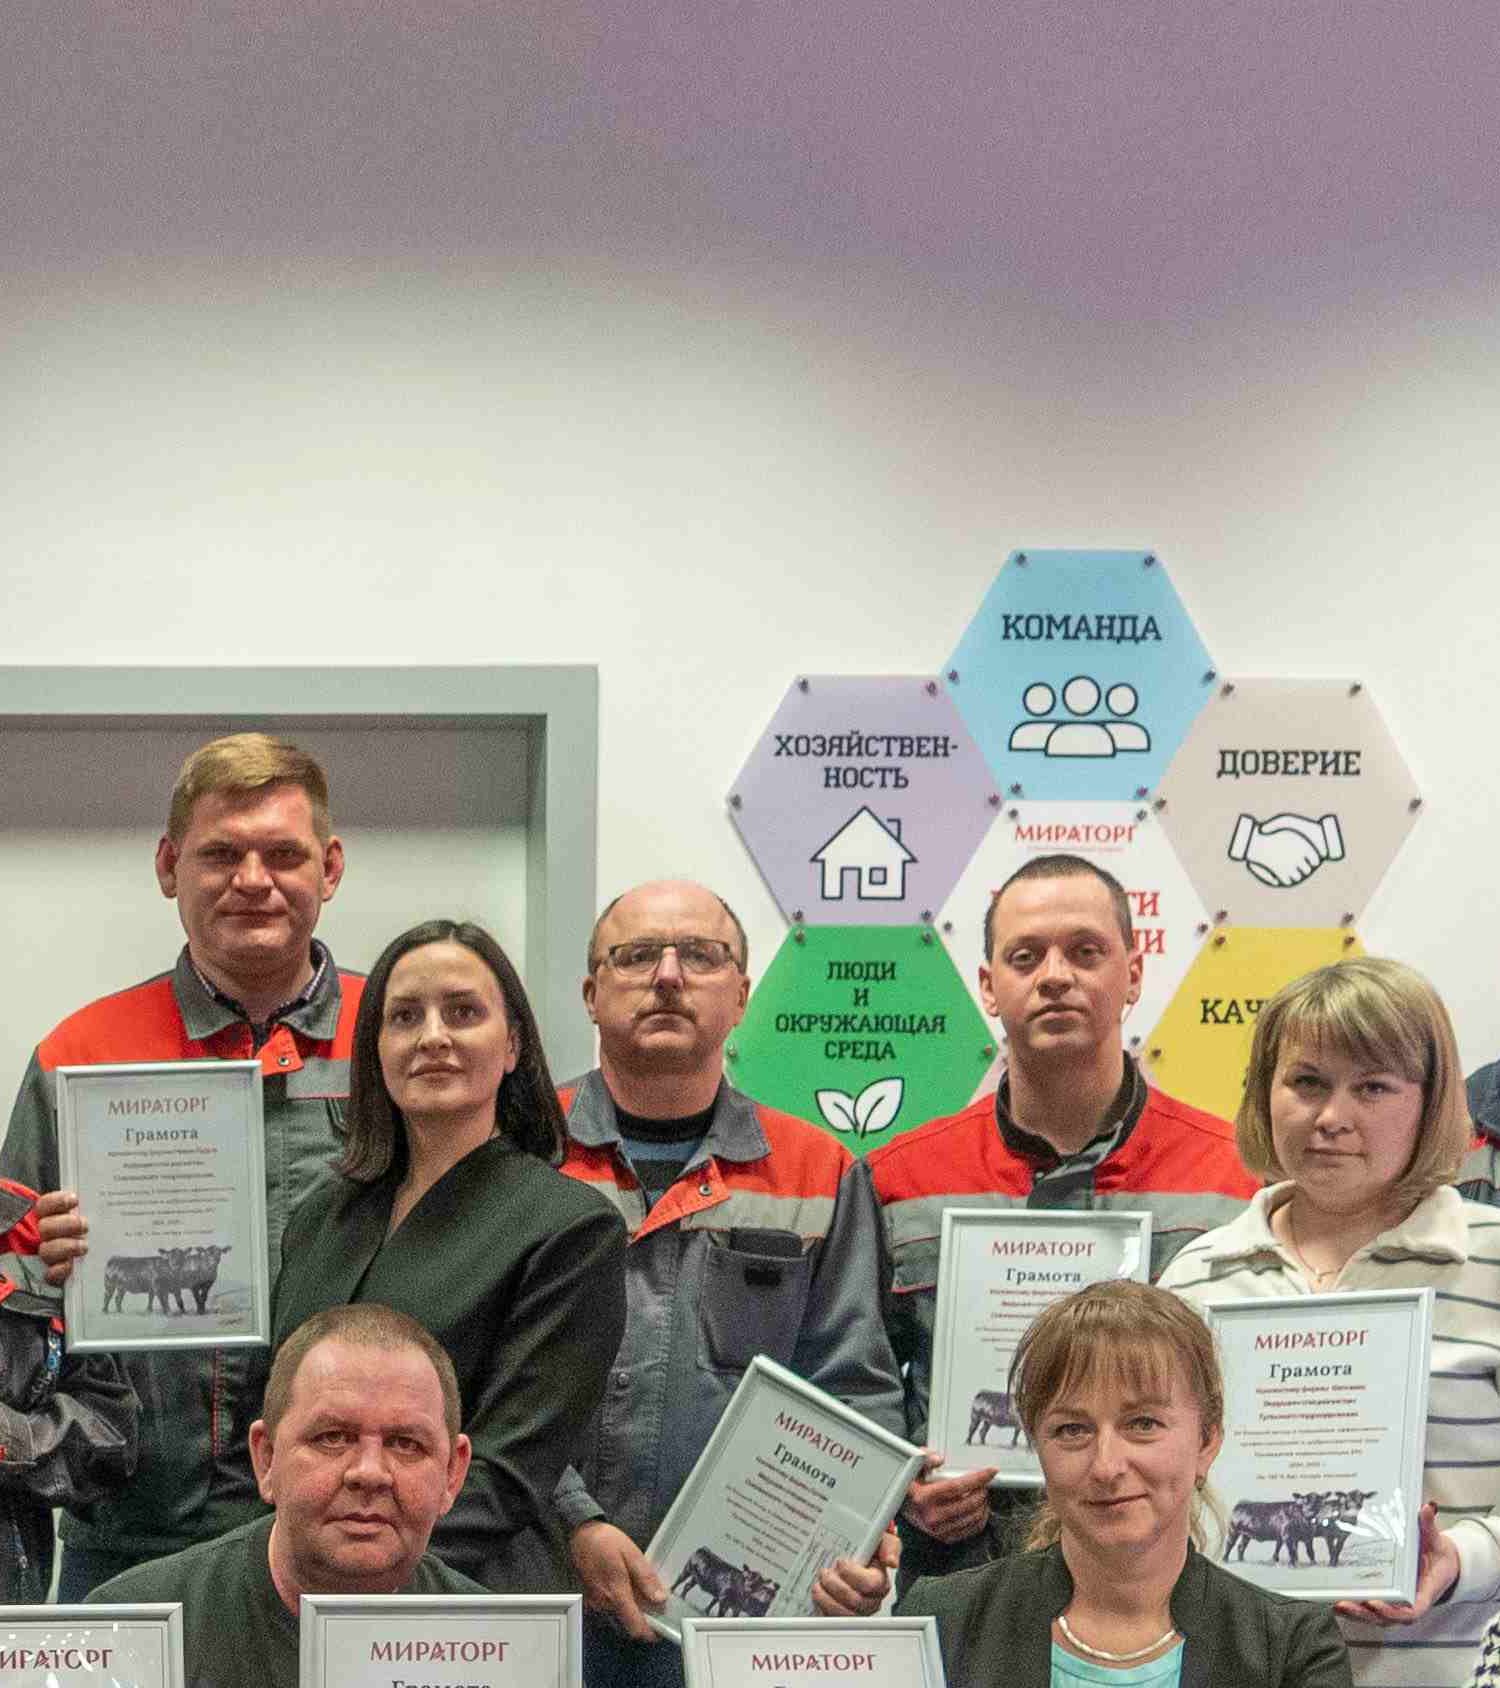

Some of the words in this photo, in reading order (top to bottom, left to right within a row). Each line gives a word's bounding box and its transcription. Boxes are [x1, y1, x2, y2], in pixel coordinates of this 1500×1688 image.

[1002, 614, 1162, 644] КОМАНДА
[775, 731, 958, 758] ХОЗЯЙСТВЕН-
[1217, 750, 1361, 779] ДОВЕРИЕ
[824, 766, 909, 788] НОСТЬ
[1015, 824, 1137, 842] МИРАТОРГ
[827, 962, 896, 983] ЛЮДИ
[853, 988, 869, 1007] И
[776, 1014, 946, 1036] ОКРУЖАЮЩАЯ
[824, 1040, 896, 1062] СРЕДА
[108, 1096, 209, 1115] МИРАТОРГ
[126, 1128, 198, 1145] Грамота
[992, 1242, 1096, 1257] МИРАТОРГ
[1007, 1269, 1081, 1284] Грамота
[1255, 1330, 1368, 1349] МИРАТОРГ
[1270, 1364, 1351, 1382] Грамота
[775, 1411, 864, 1468] МИРАТОРГ
[773, 1443, 836, 1489] Грамота
[371, 1642, 510, 1662] МИРАТОРГ
[752, 1654, 876, 1670] МИРАТОРГ
